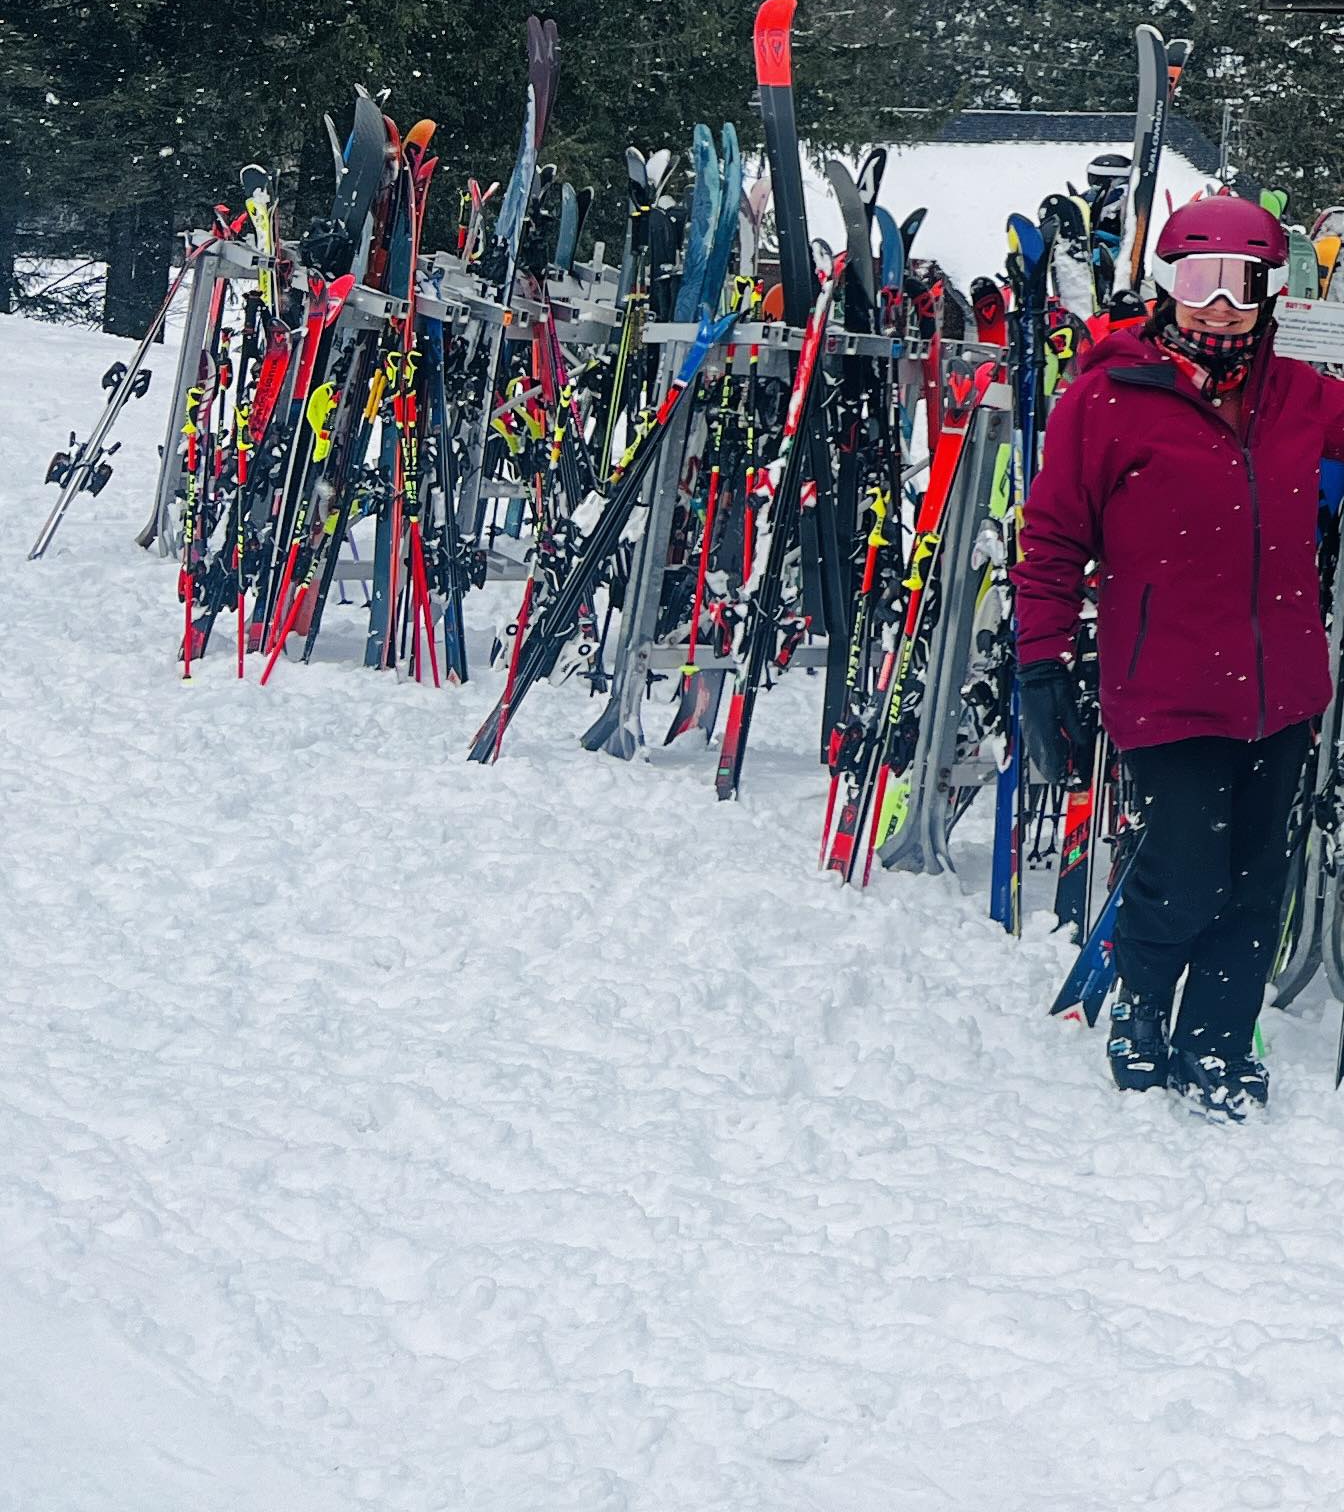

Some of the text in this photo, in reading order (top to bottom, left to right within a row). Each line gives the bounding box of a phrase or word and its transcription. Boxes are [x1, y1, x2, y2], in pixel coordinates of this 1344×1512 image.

[1147, 99, 1164, 174] SALOMON
[845, 643, 862, 687] LEKI
[888, 683, 903, 724] LEKI
